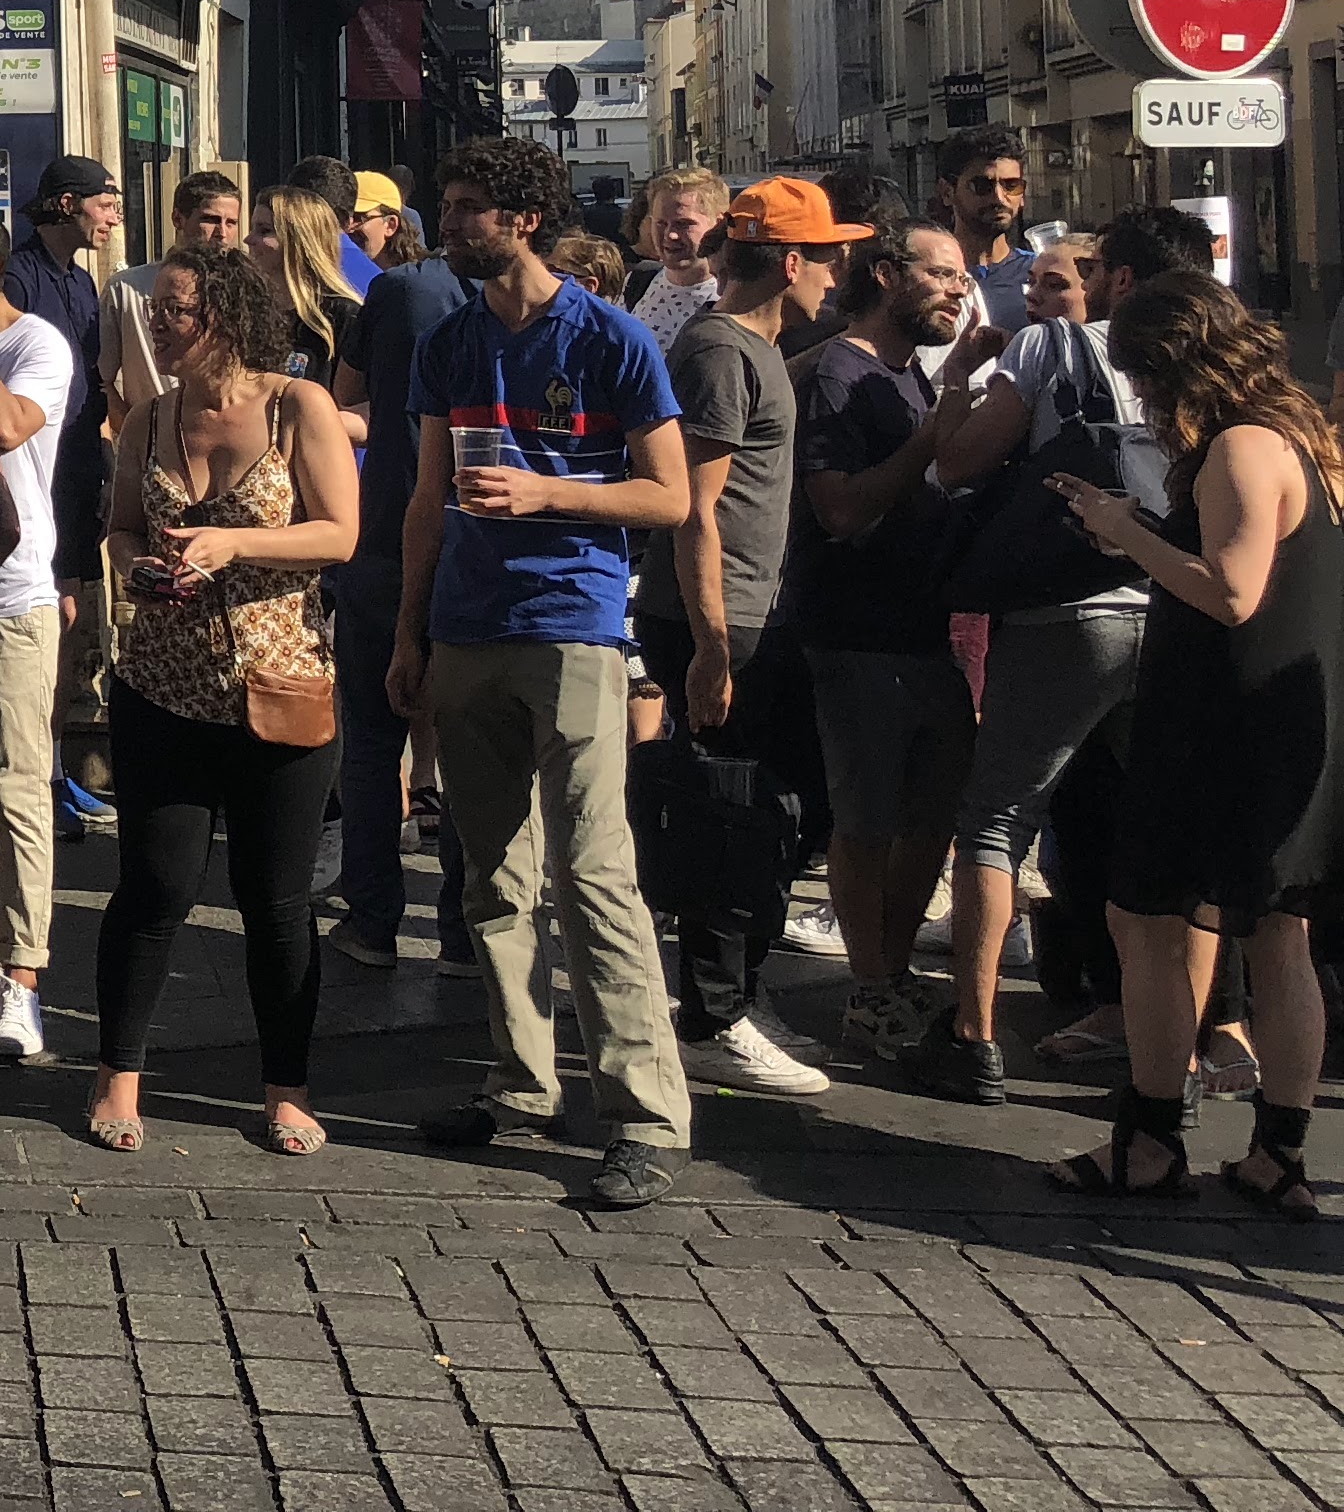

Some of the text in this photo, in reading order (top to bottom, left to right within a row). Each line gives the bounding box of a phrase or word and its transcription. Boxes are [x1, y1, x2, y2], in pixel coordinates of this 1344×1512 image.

[9, 13, 43, 26] sport
[14, 31, 46, 39] VENTE
[9, 72, 38, 80] vente
[1147, 101, 1221, 126] SAUF
